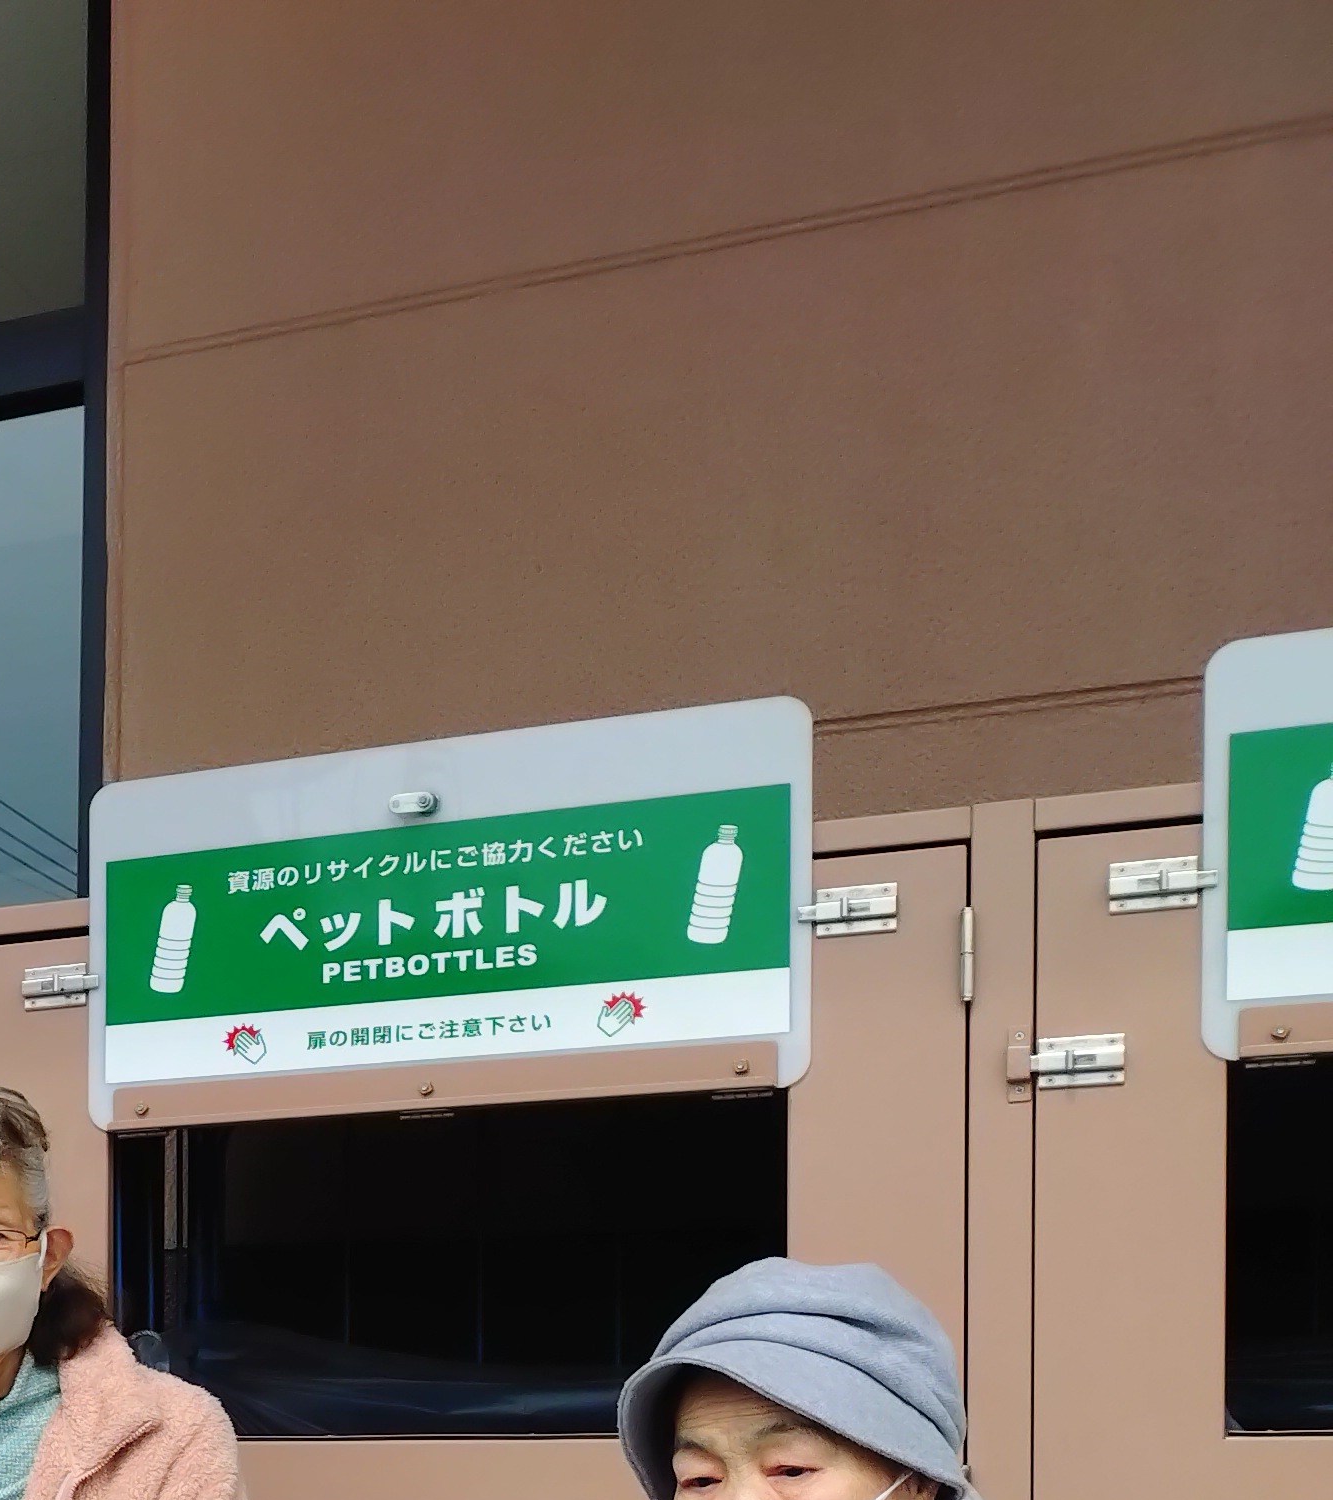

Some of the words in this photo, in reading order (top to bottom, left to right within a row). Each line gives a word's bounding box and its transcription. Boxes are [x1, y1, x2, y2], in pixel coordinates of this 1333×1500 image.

[227, 827, 643, 894] 資源のリサイクルにご協力ください
[260, 878, 607, 952] ペットボトル
[322, 944, 538, 984] PETBOTTLES
[306, 1012, 551, 1050] 扉の開閉にご注意下さい
